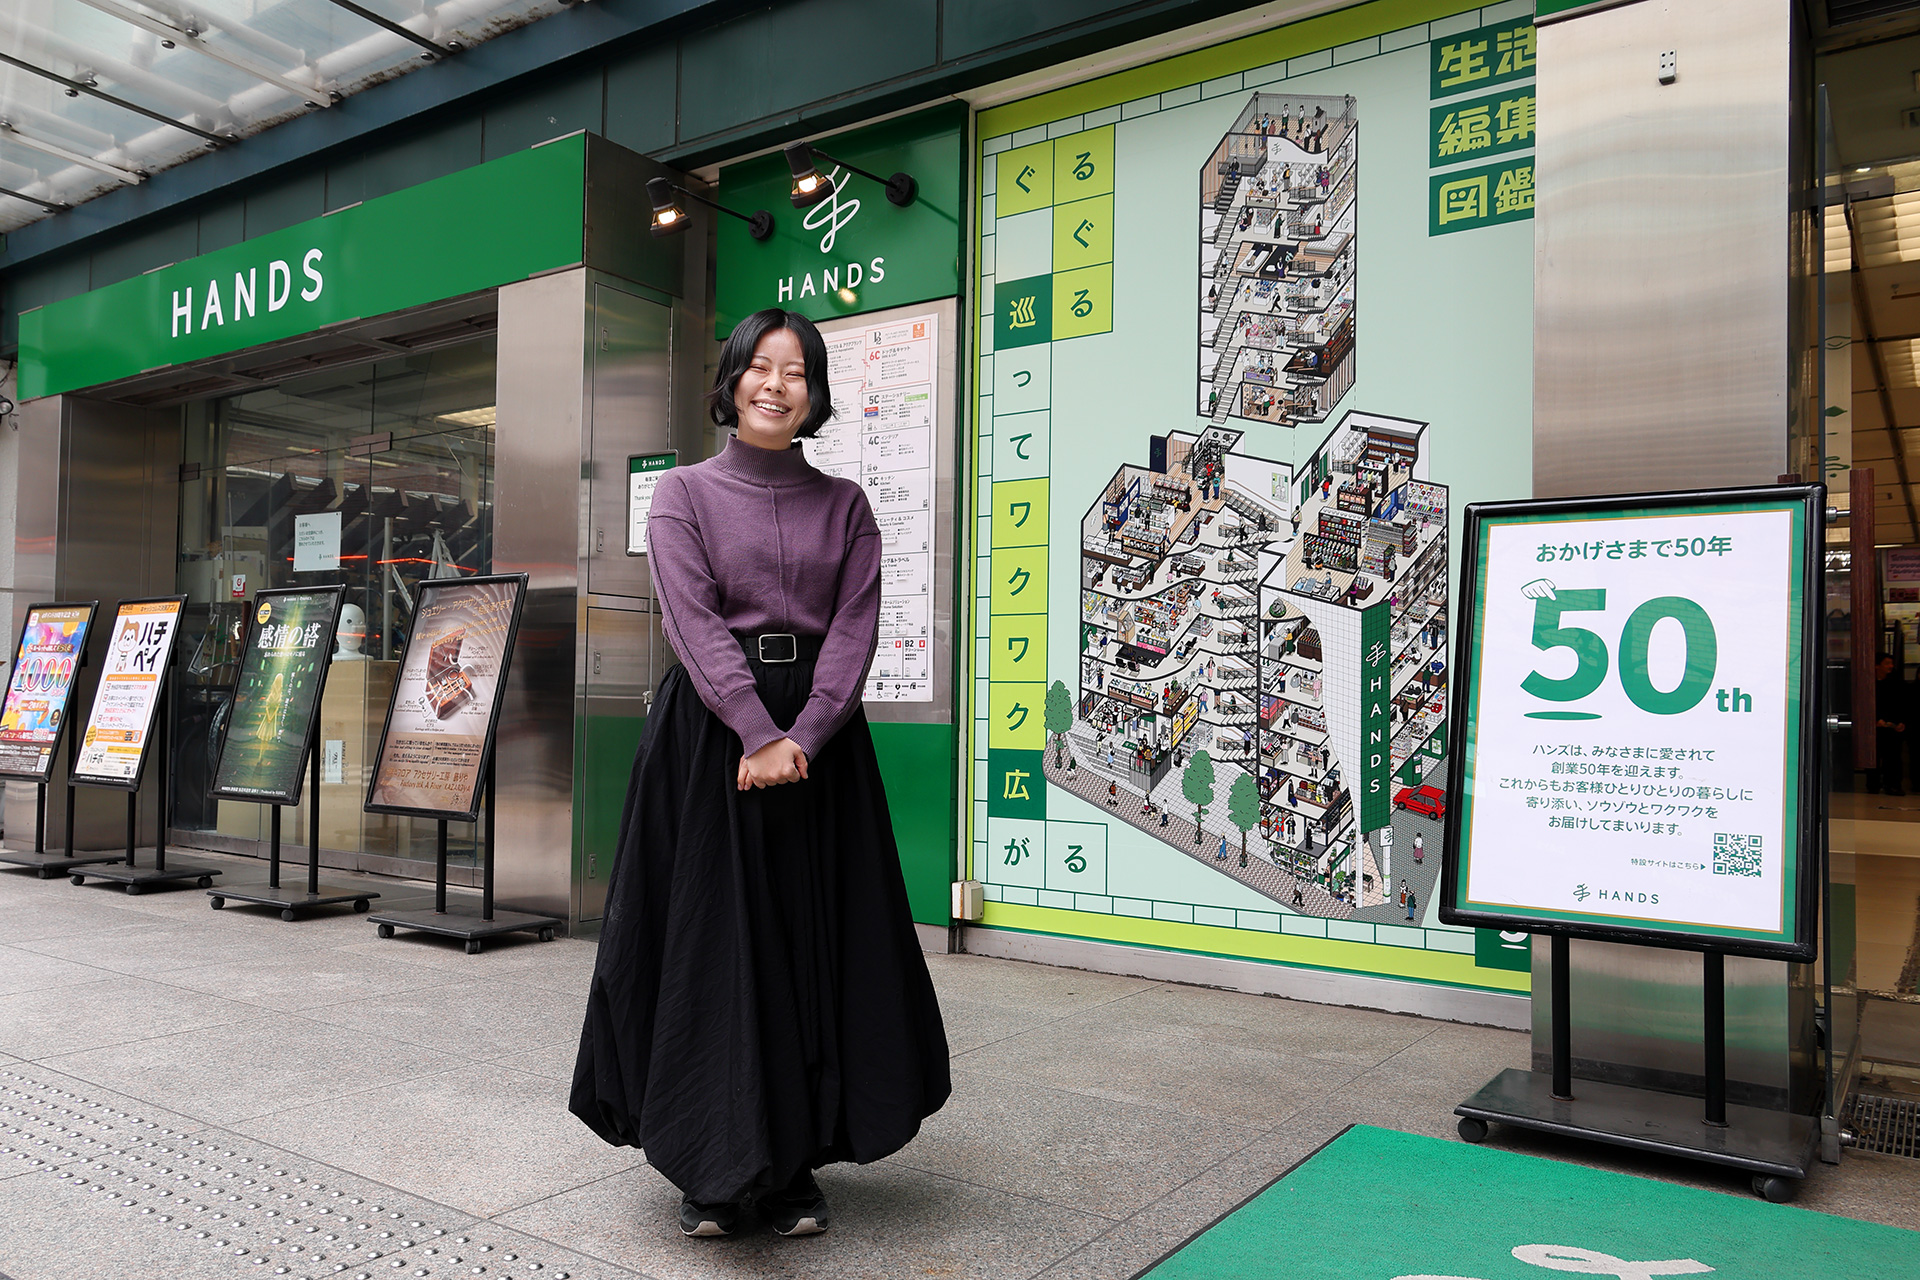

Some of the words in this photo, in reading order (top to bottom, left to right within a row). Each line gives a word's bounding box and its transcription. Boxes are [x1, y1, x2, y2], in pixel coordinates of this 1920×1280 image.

[1437, 25, 1536, 89] 生活
[1437, 96, 1536, 158] 編集
[778, 256, 885, 303] HANDS
[171, 248, 325, 338] HANDS
[869, 350, 881, 361] 6C
[869, 394, 880, 405] 5C
[868, 435, 880, 446] 4C
[867, 476, 879, 487] 3C
[1535, 535, 1733, 563] おかげさまで50年
[138, 621, 169, 647] ハチ
[257, 622, 322, 649] 感情の塔
[904, 639, 915, 648] B2
[133, 647, 162, 672] ペイ
[1519, 588, 1753, 715] 50th
[14, 655, 74, 693] 1,000
[1369, 677, 1383, 794] HANDS
[1532, 743, 1716, 762] ハンズは、みなさまに愛されて
[1550, 761, 1685, 780] 創業50年を迎えます。
[1498, 778, 1754, 802] これからもお客様ひとりひとりの暮らしに
[1525, 796, 1719, 819] 寄り添い、ソウゾウとワクワクを
[1547, 815, 1684, 837] お届けしてまいります。
[1630, 857, 1700, 871] 特設サイトはこちら
[1598, 888, 1660, 905] HANDS
